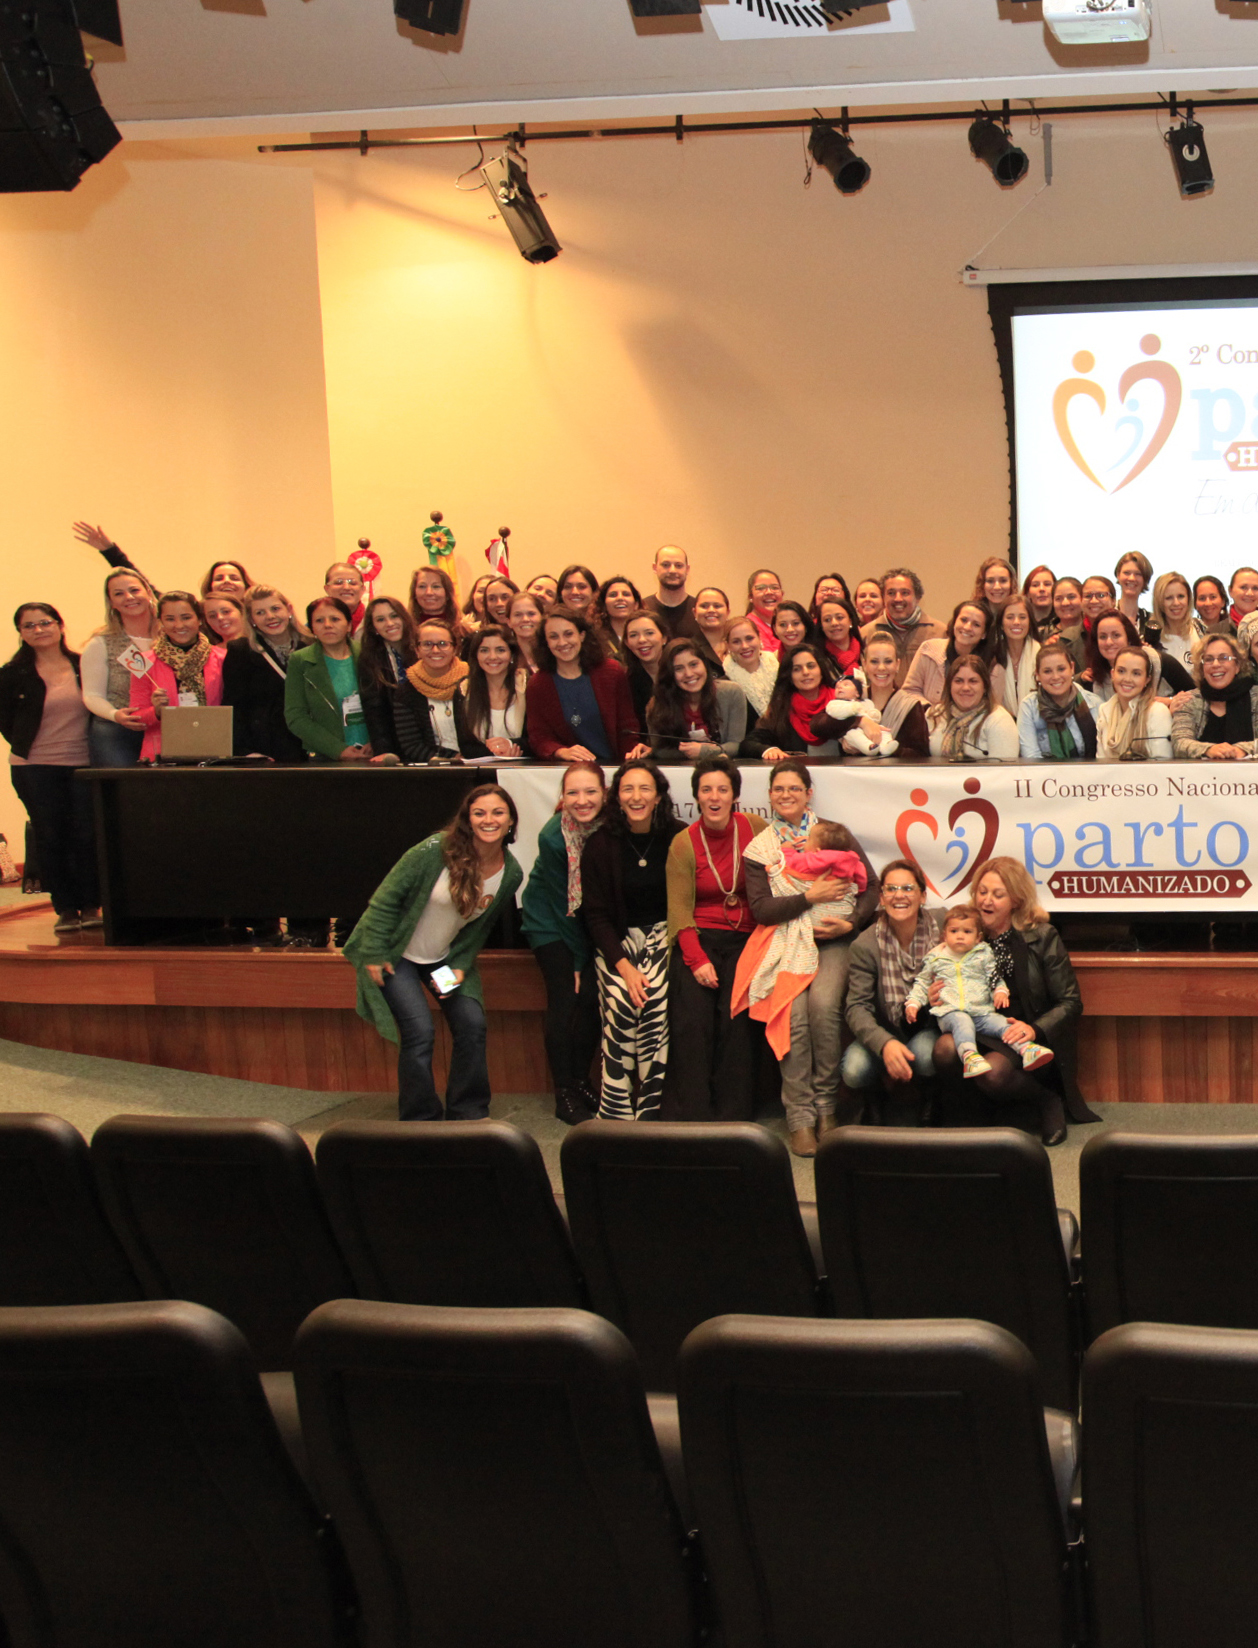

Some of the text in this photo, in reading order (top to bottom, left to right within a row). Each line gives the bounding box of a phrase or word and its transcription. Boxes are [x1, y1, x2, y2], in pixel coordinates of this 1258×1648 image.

[1014, 779, 1032, 798] II
[1041, 778, 1158, 801] Congresso
[1016, 804, 1249, 885] parto
[1062, 876, 1230, 894] HUMANIZADO
